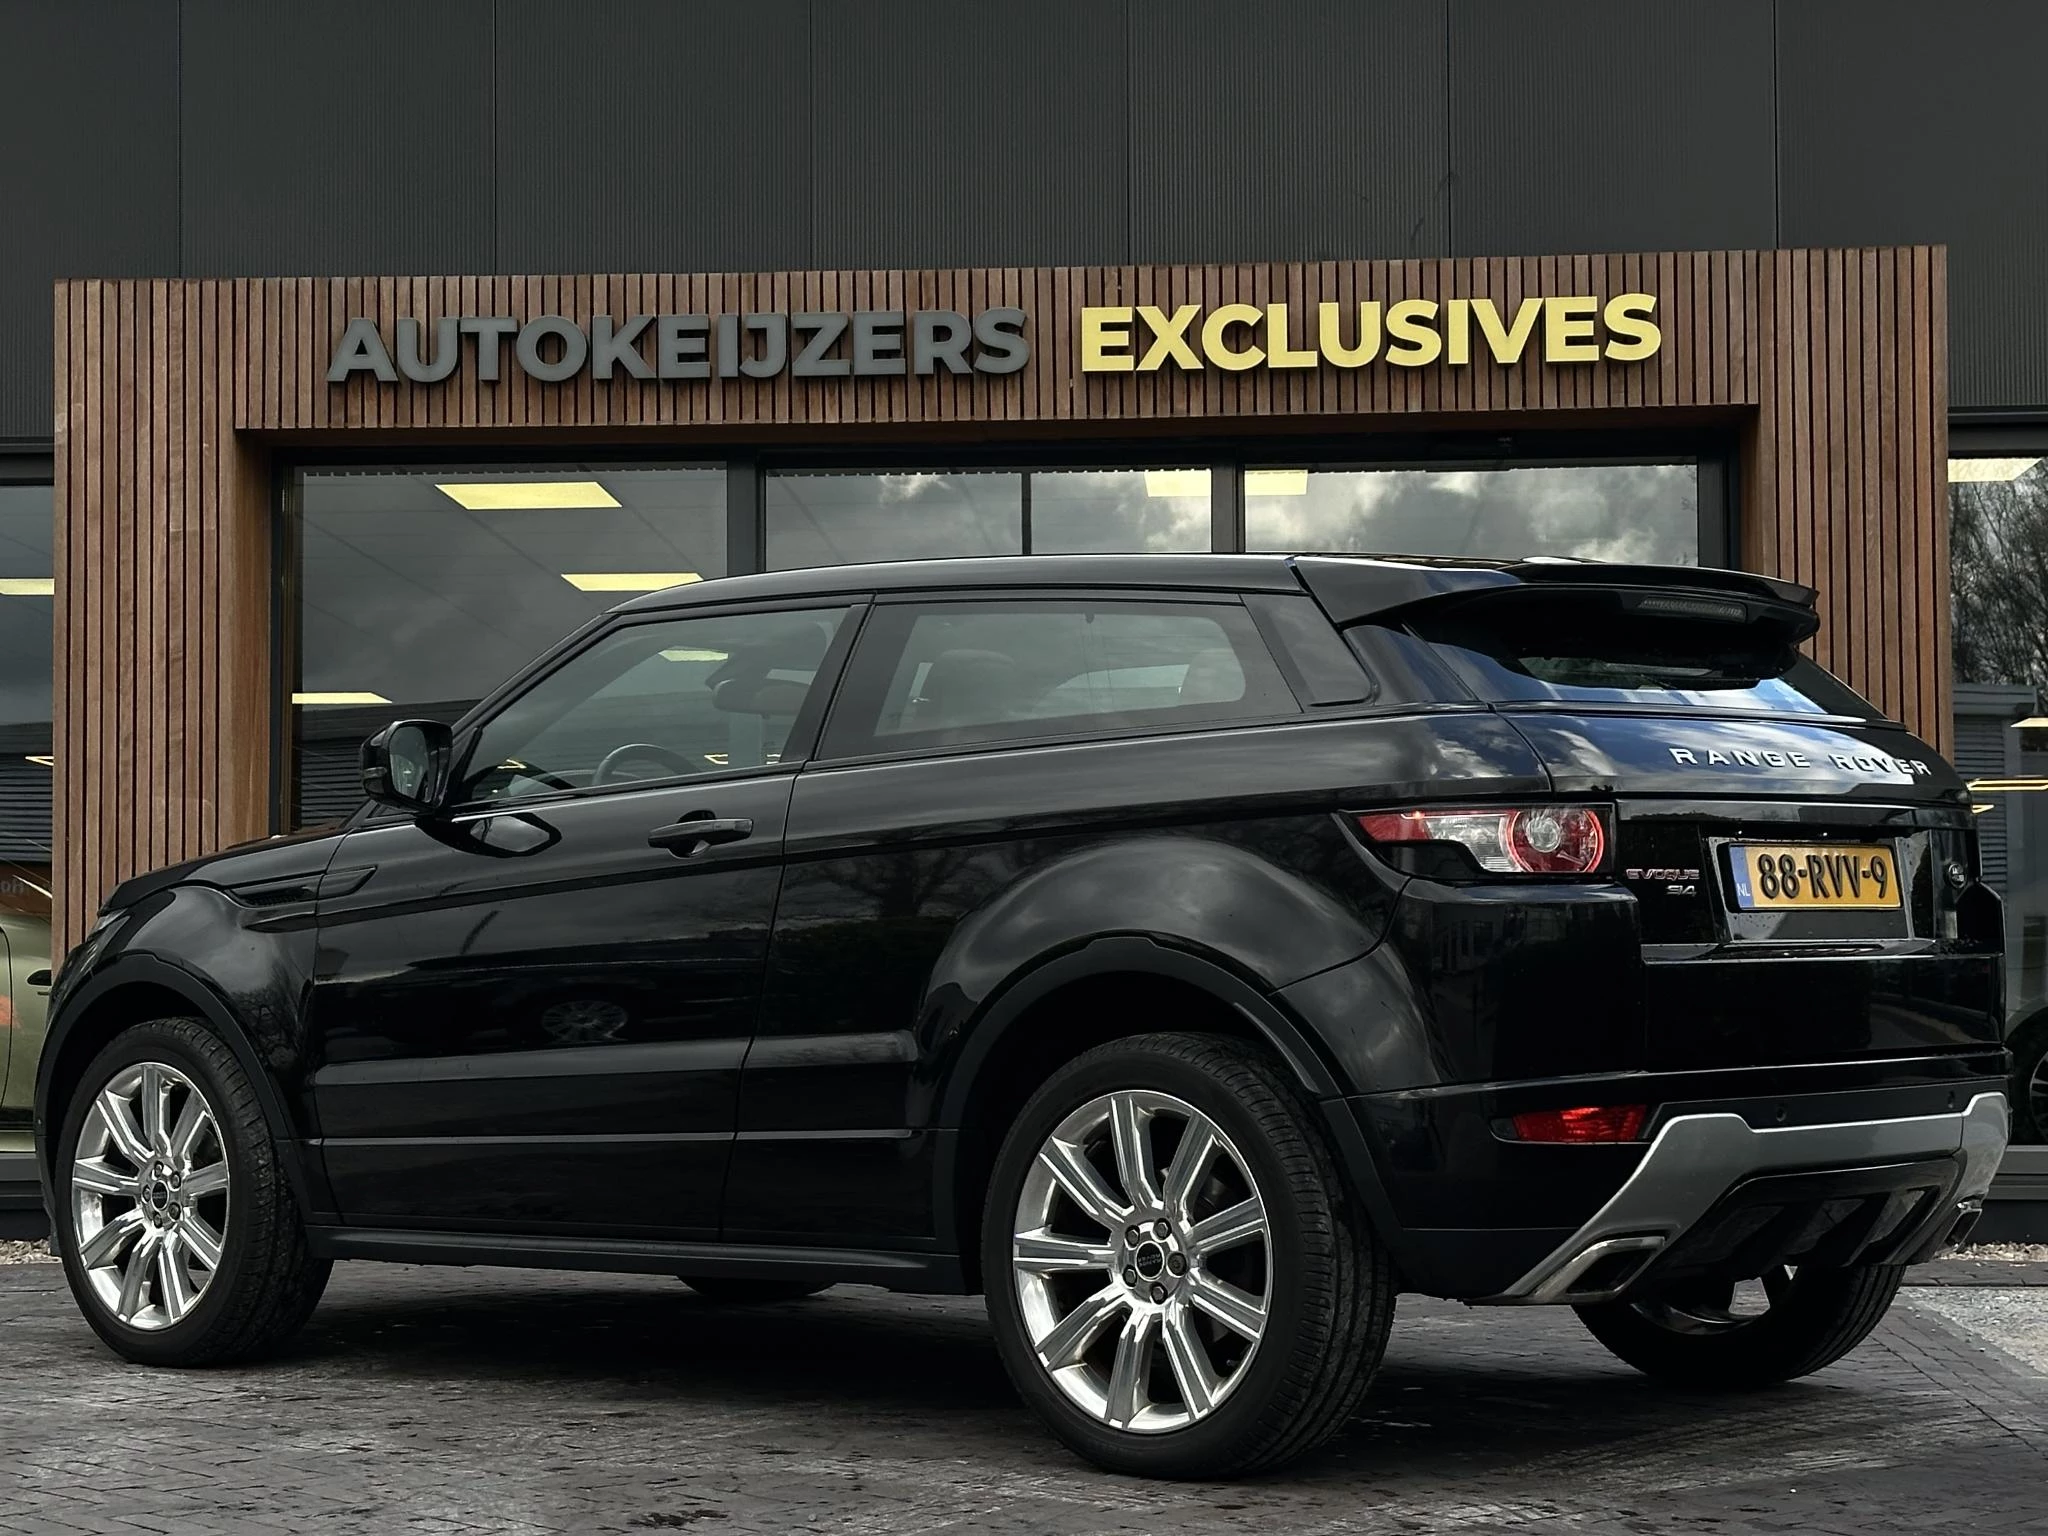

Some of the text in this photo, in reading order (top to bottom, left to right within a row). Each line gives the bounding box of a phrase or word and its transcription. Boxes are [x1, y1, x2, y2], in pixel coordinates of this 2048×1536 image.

[328, 293, 1662, 383] AUTOKEIJZERS EXCLUSIVES
[1669, 747, 1932, 776] RANGE ROVER
[1625, 868, 1700, 881] EVOQUE
[1756, 853, 1888, 900] 88-RVV-9
